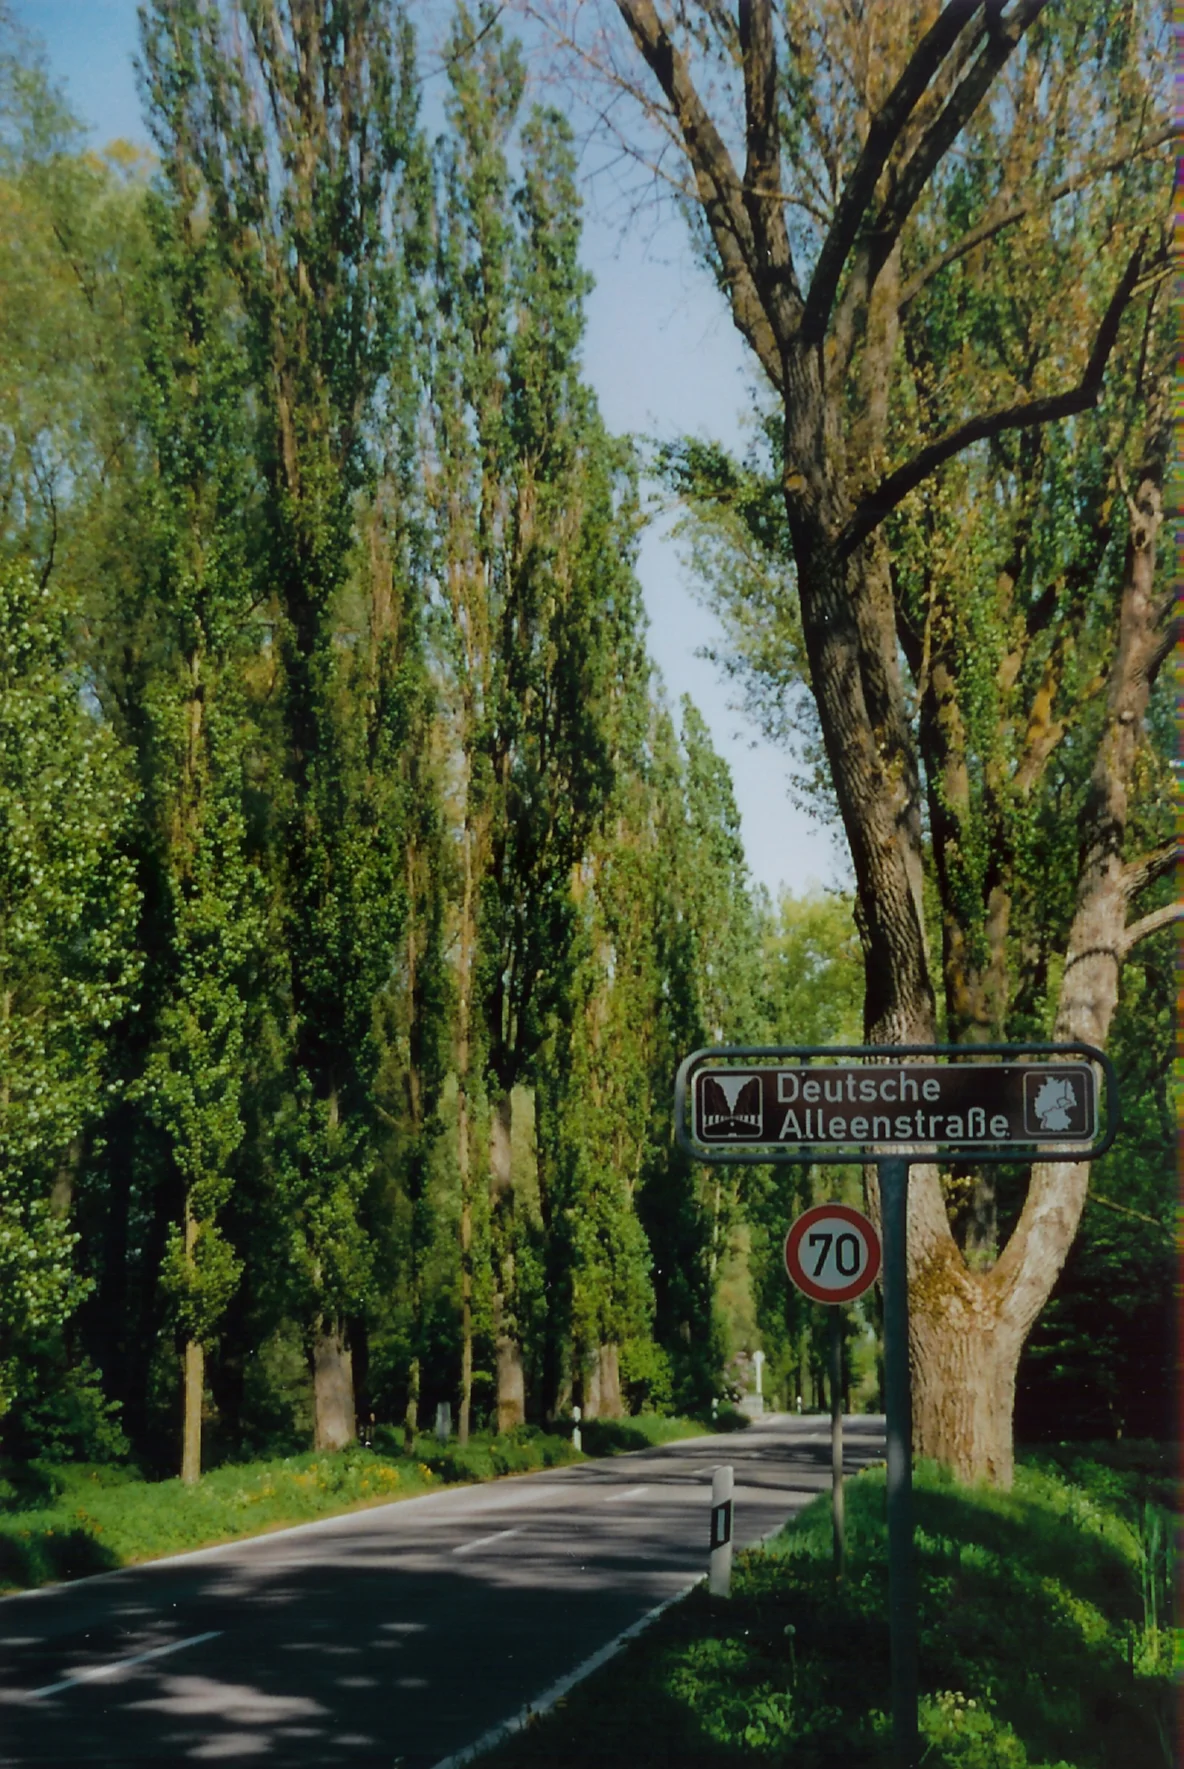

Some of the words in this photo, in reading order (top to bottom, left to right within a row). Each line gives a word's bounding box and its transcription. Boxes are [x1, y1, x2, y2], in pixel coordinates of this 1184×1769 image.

[776, 1072, 941, 1102] Deutsche
[778, 1107, 1009, 1140] Alleenstraße
[808, 1233, 861, 1277] 70
